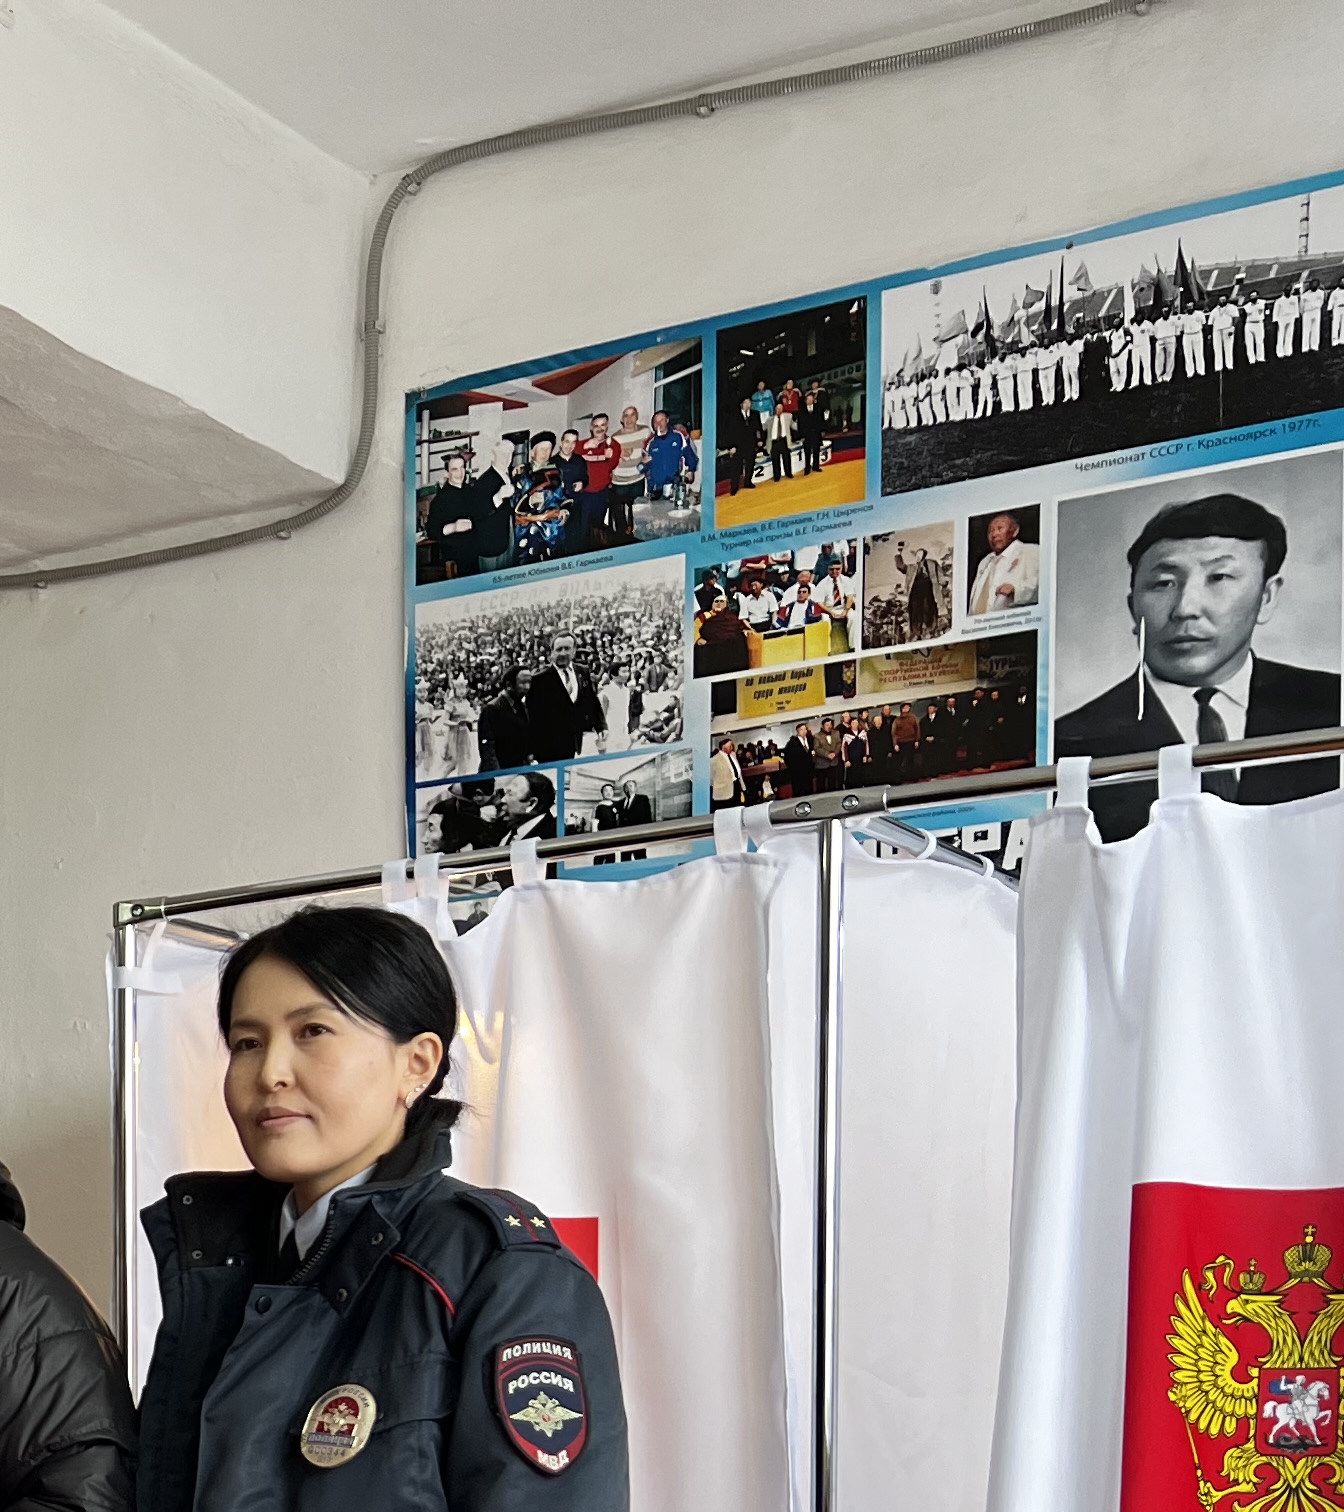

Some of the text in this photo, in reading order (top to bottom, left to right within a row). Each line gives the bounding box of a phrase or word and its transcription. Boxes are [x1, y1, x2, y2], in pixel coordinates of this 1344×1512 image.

[1075, 450, 1147, 473] Чемпионат
[1150, 443, 1184, 459] СССР
[1197, 427, 1278, 451] Красноярск
[1281, 418, 1321, 434] 1977г.
[720, 538, 753, 551] Турнир
[753, 537, 763, 545] на
[765, 531, 794, 543] призы
[502, 1342, 573, 1361] ПОЛИЦИЯ
[508, 1371, 575, 1394] РОССИЯ
[537, 1449, 570, 1471] МВД
